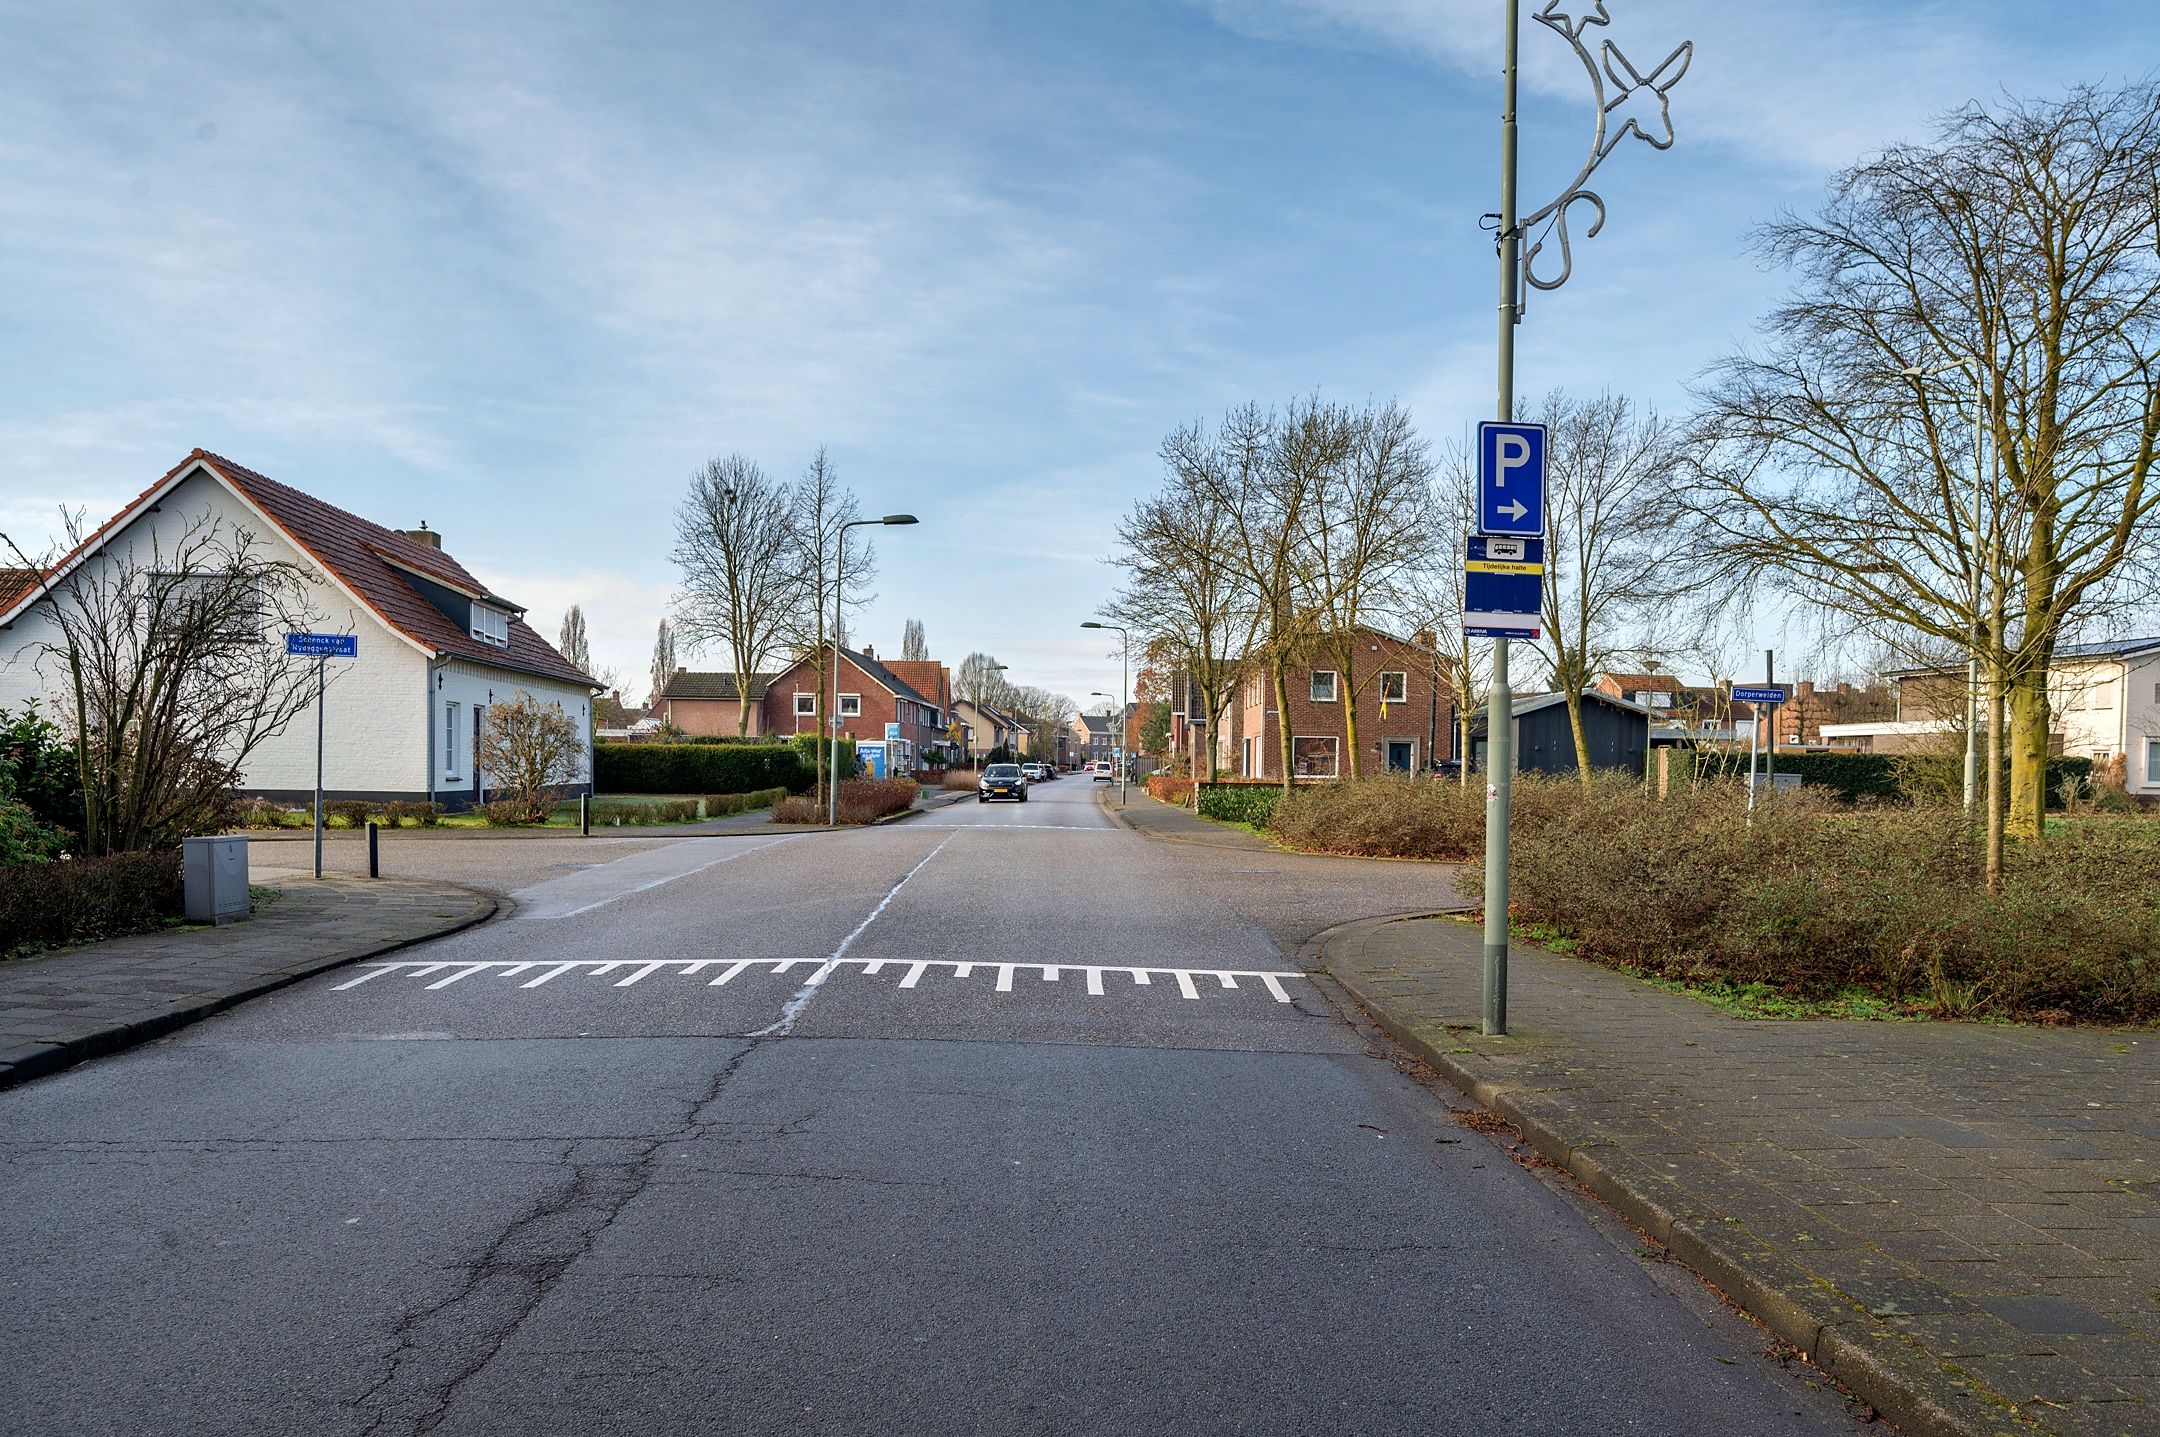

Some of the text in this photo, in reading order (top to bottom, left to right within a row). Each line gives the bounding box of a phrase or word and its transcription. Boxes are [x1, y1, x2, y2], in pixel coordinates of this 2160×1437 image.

[1496, 433, 1531, 487] P
[1483, 563, 1510, 571] Tijdelijke
[1735, 690, 1782, 699] Dorperweiden
